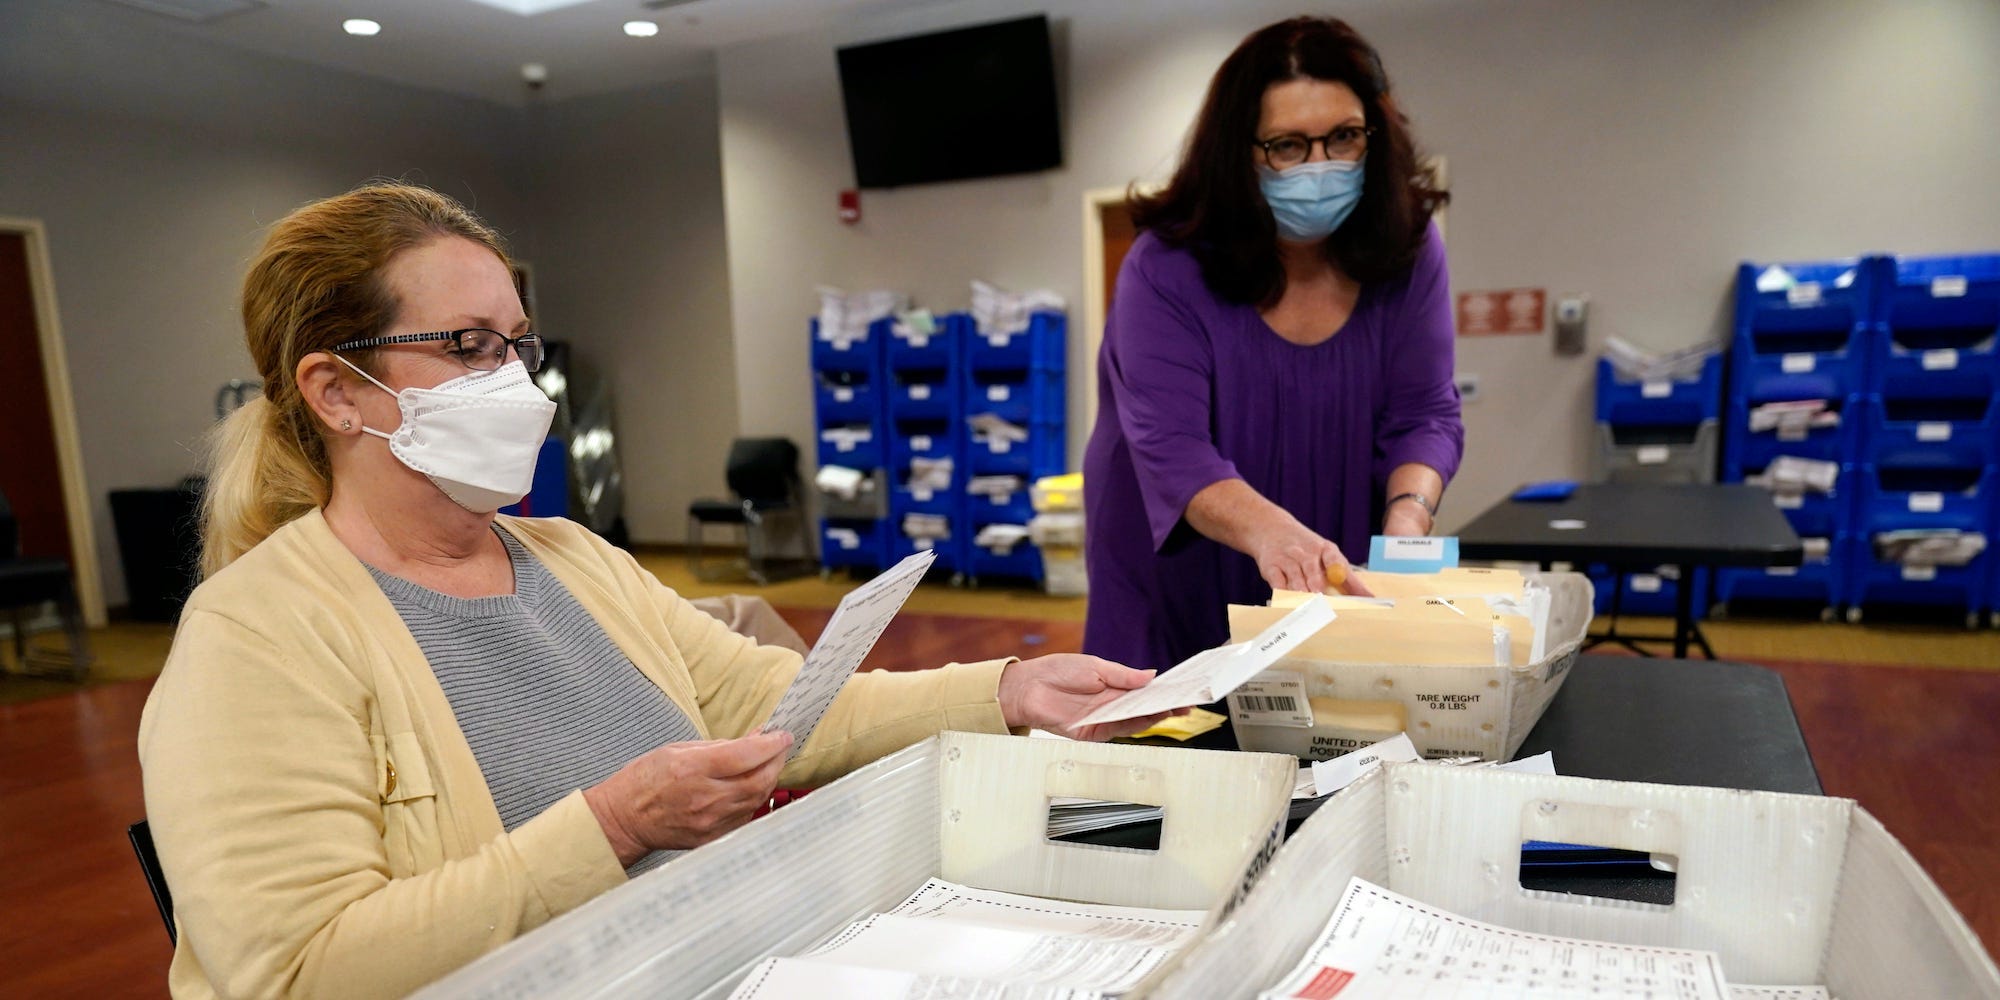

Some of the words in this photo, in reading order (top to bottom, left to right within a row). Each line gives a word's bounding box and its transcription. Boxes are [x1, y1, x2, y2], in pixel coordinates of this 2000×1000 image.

[1416, 694, 1440, 702] TARE
[1442, 694, 1480, 702] WEIGHT
[1312, 736, 1357, 748] UNITED
